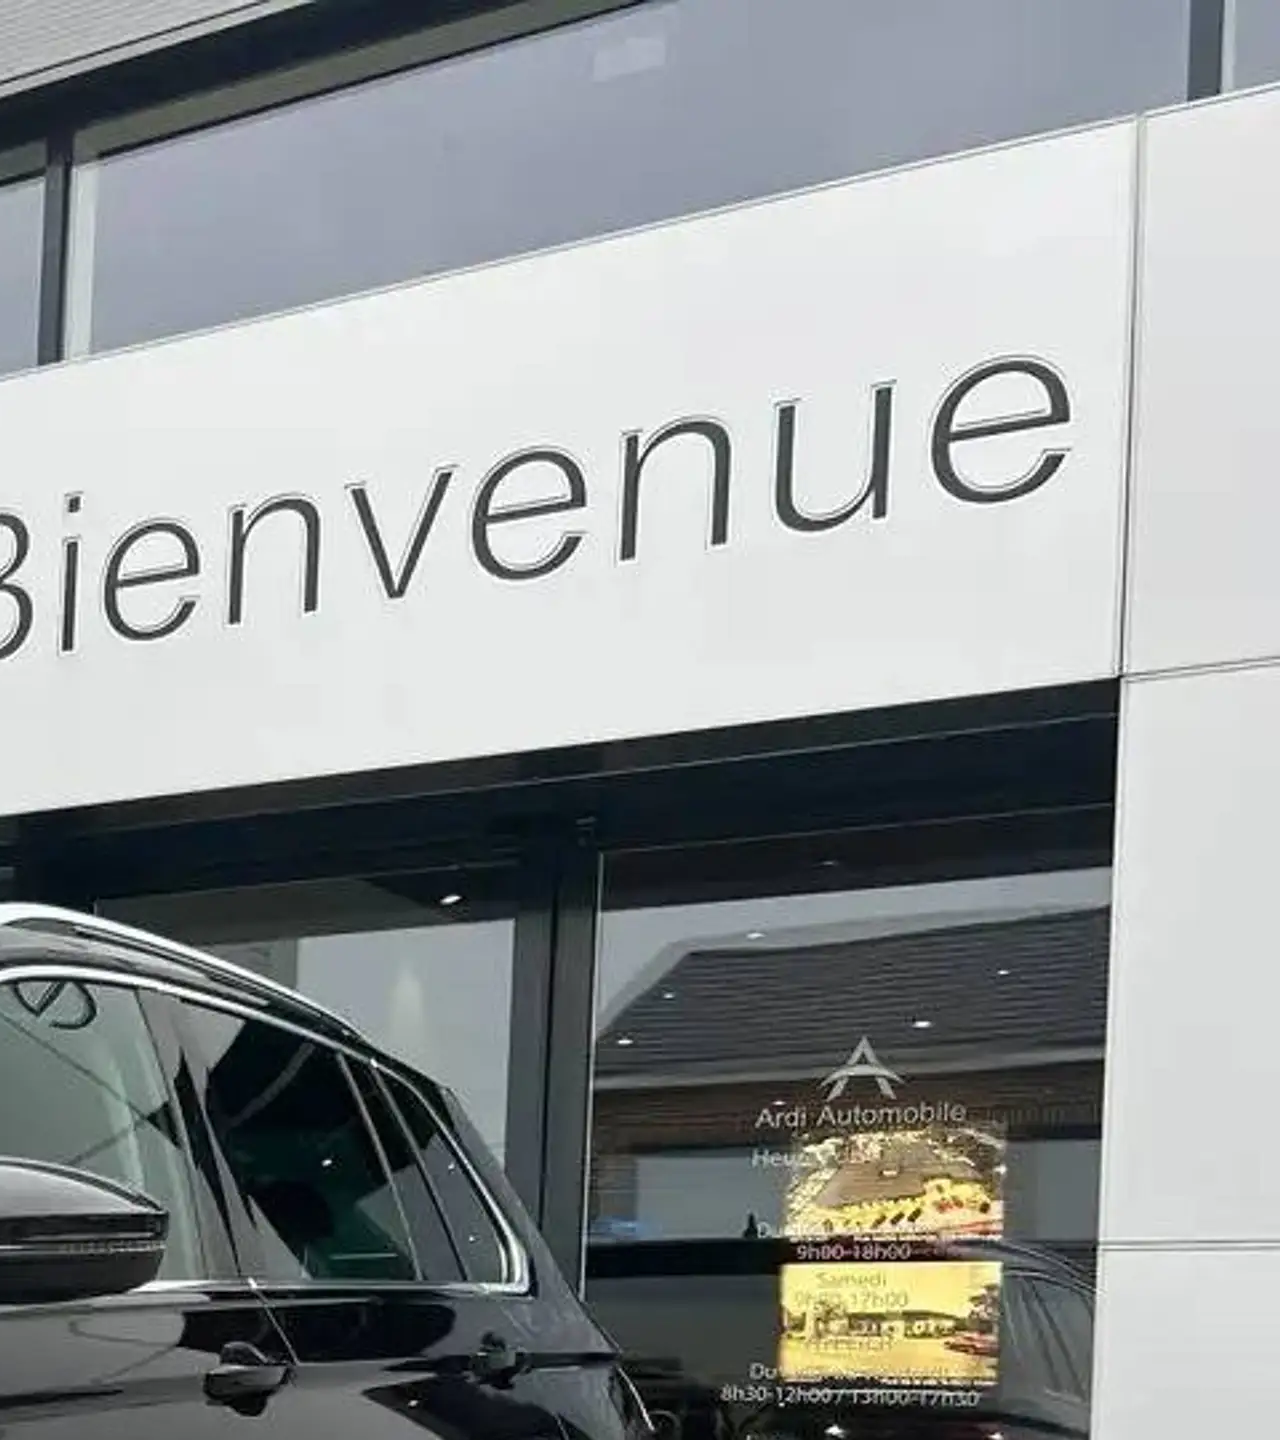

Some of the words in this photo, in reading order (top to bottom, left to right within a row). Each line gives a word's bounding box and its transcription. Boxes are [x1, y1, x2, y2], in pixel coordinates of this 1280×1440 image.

[755, 1105, 807, 1129] Ardi
[815, 1101, 967, 1127] Automobile
[796, 1243, 911, 1260] 9h00-18h00
